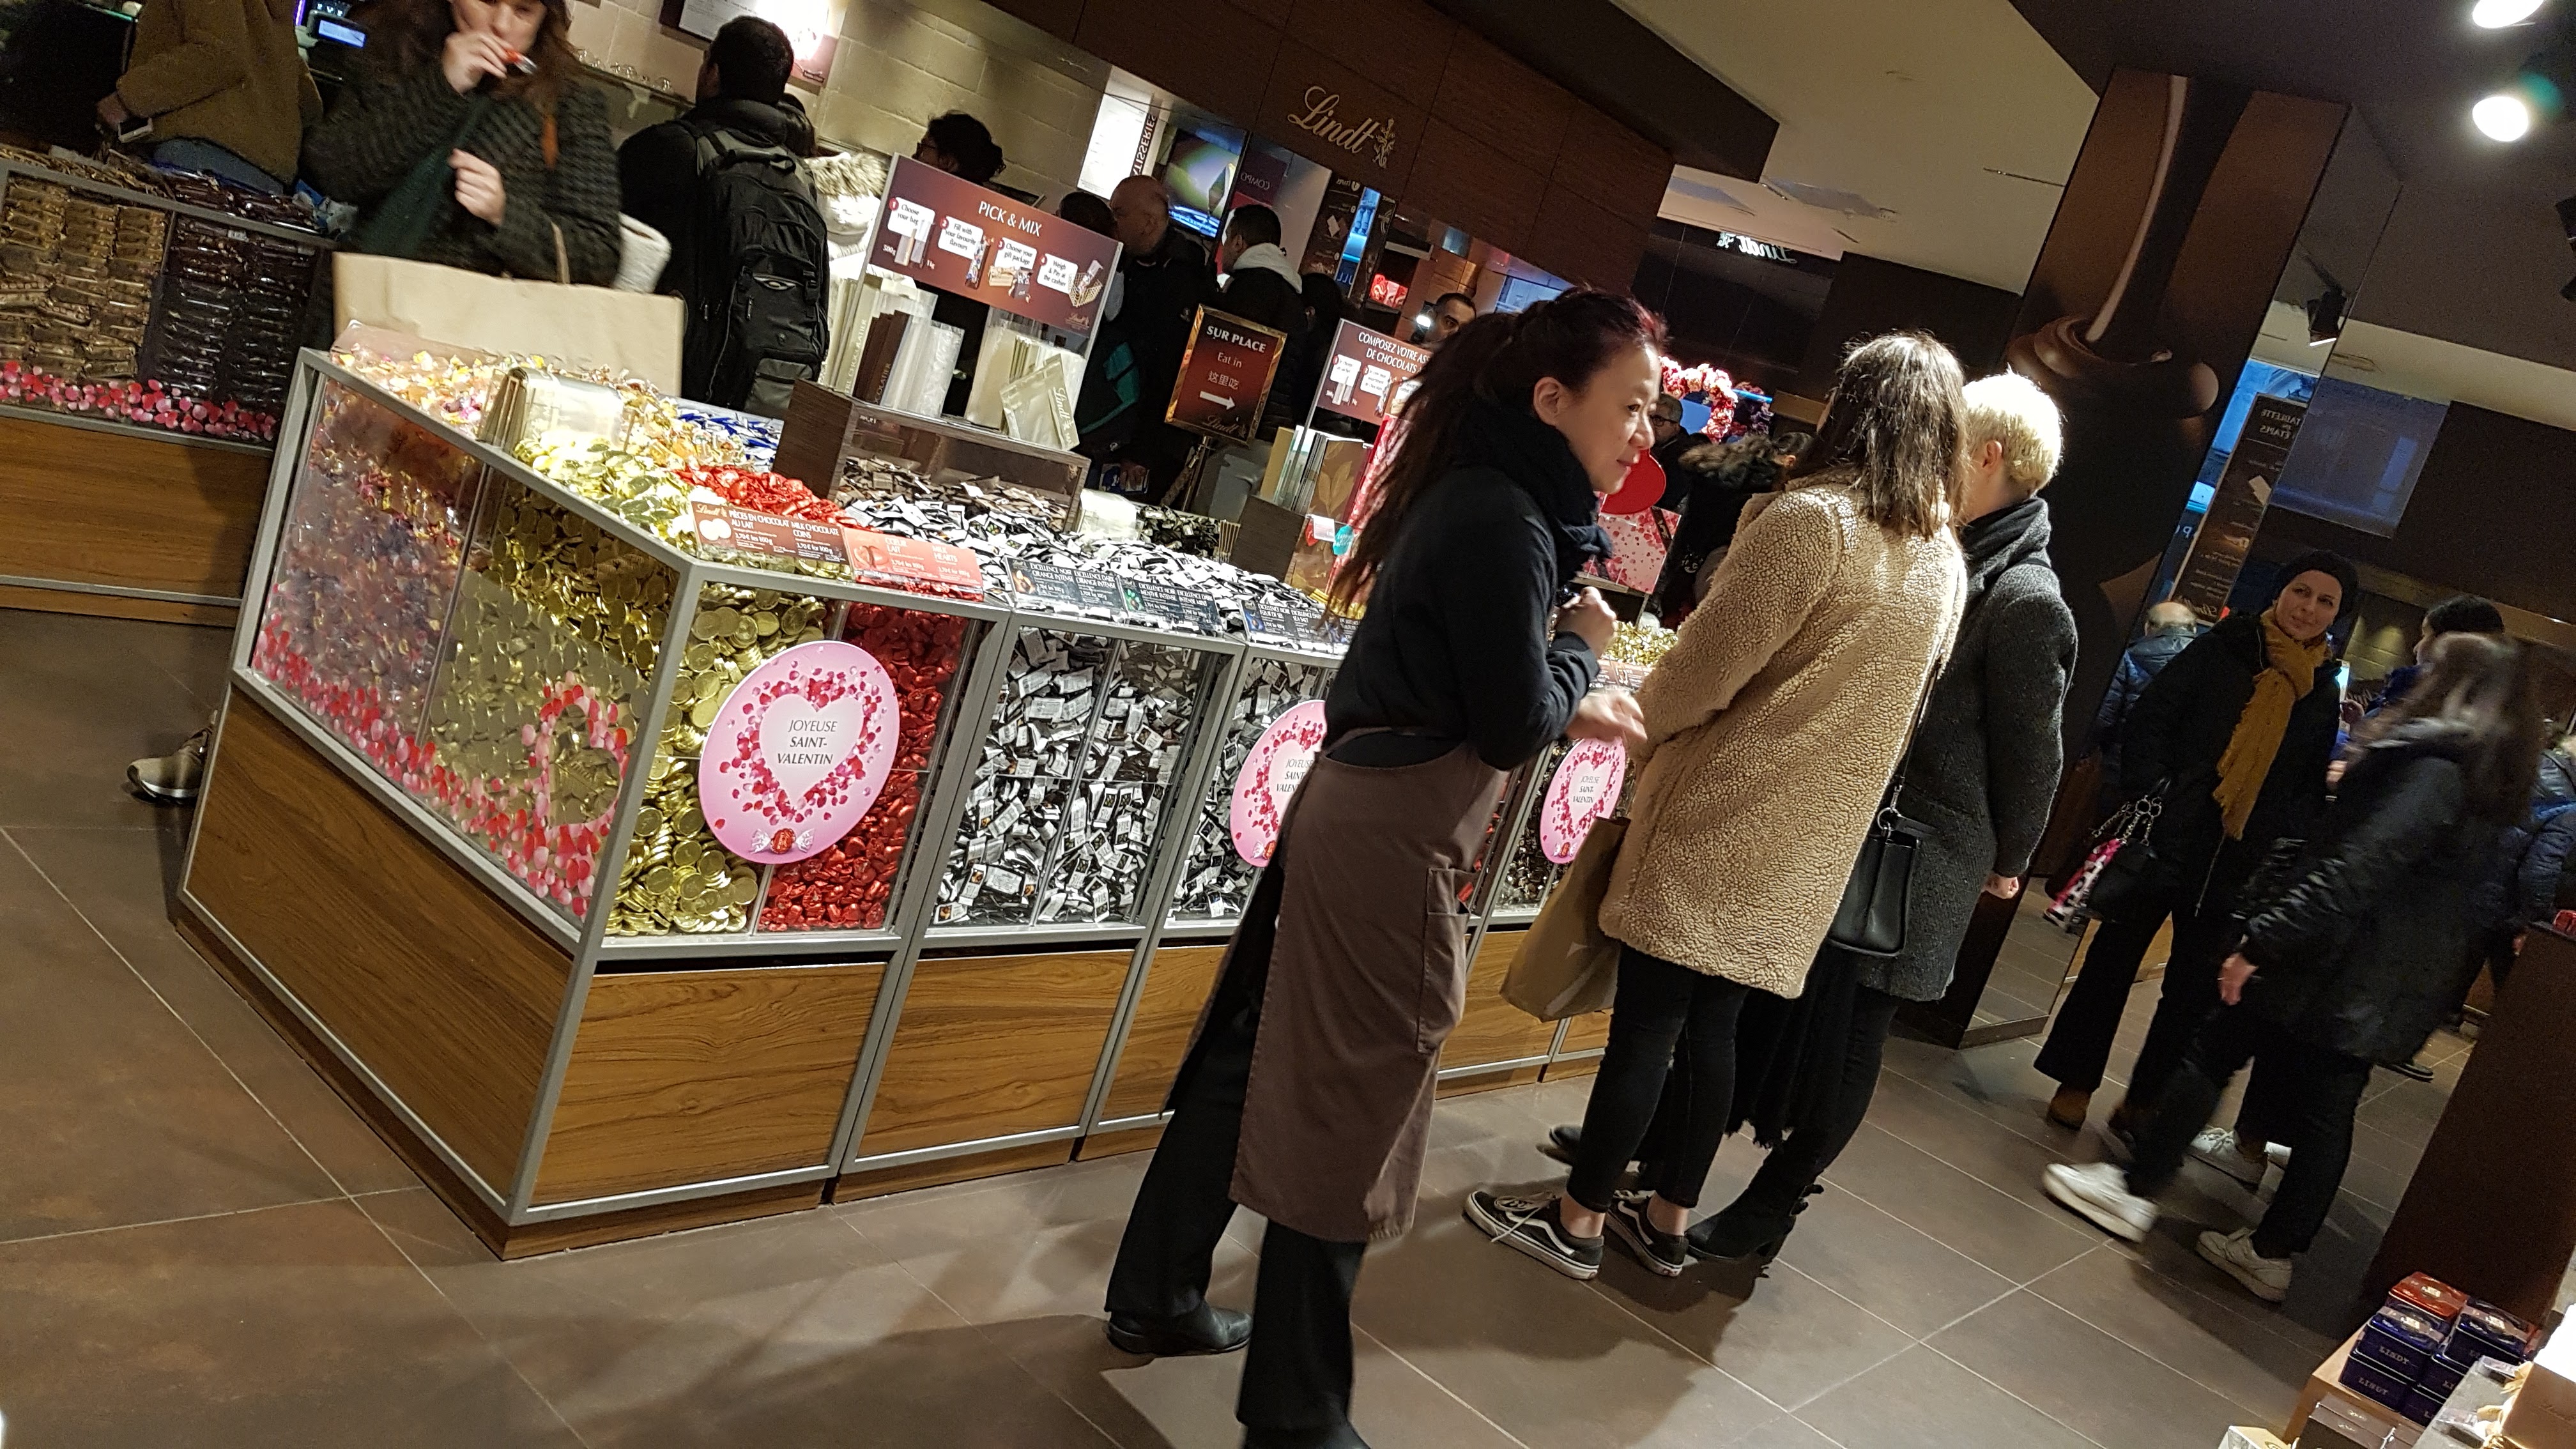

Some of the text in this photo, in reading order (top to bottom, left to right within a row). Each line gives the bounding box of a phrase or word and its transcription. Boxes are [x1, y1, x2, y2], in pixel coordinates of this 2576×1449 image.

[1287, 86, 1381, 153] Lindt
[901, 204, 919, 215] Choose
[910, 215, 919, 226] bag
[978, 201, 1042, 237] PICK & MIX
[953, 224, 972, 236] Fill with
[1006, 243, 1033, 258] Choose your
[1012, 254, 1031, 266] package
[1053, 260, 1066, 270] Weigh
[1206, 325, 1266, 353] SUR PLACE
[1358, 332, 1397, 353] COMPOSEZ
[1397, 346, 1417, 361] VOTRE
[1217, 352, 1243, 368] Eat in
[1366, 348, 1376, 360] DE
[1376, 351, 1418, 374] CHOCOLATS
[1054, 387, 1071, 422] Lindt
[741, 521, 754, 530] LAIT
[758, 516, 790, 527] CHOCOLAT
[791, 521, 839, 535] MILK CHOCOLATE
[933, 553, 958, 562] HEARTS
[788, 719, 838, 733] JOYEUSE
[790, 736, 828, 748] SAINT-
[777, 753, 834, 765] VALENTIN
